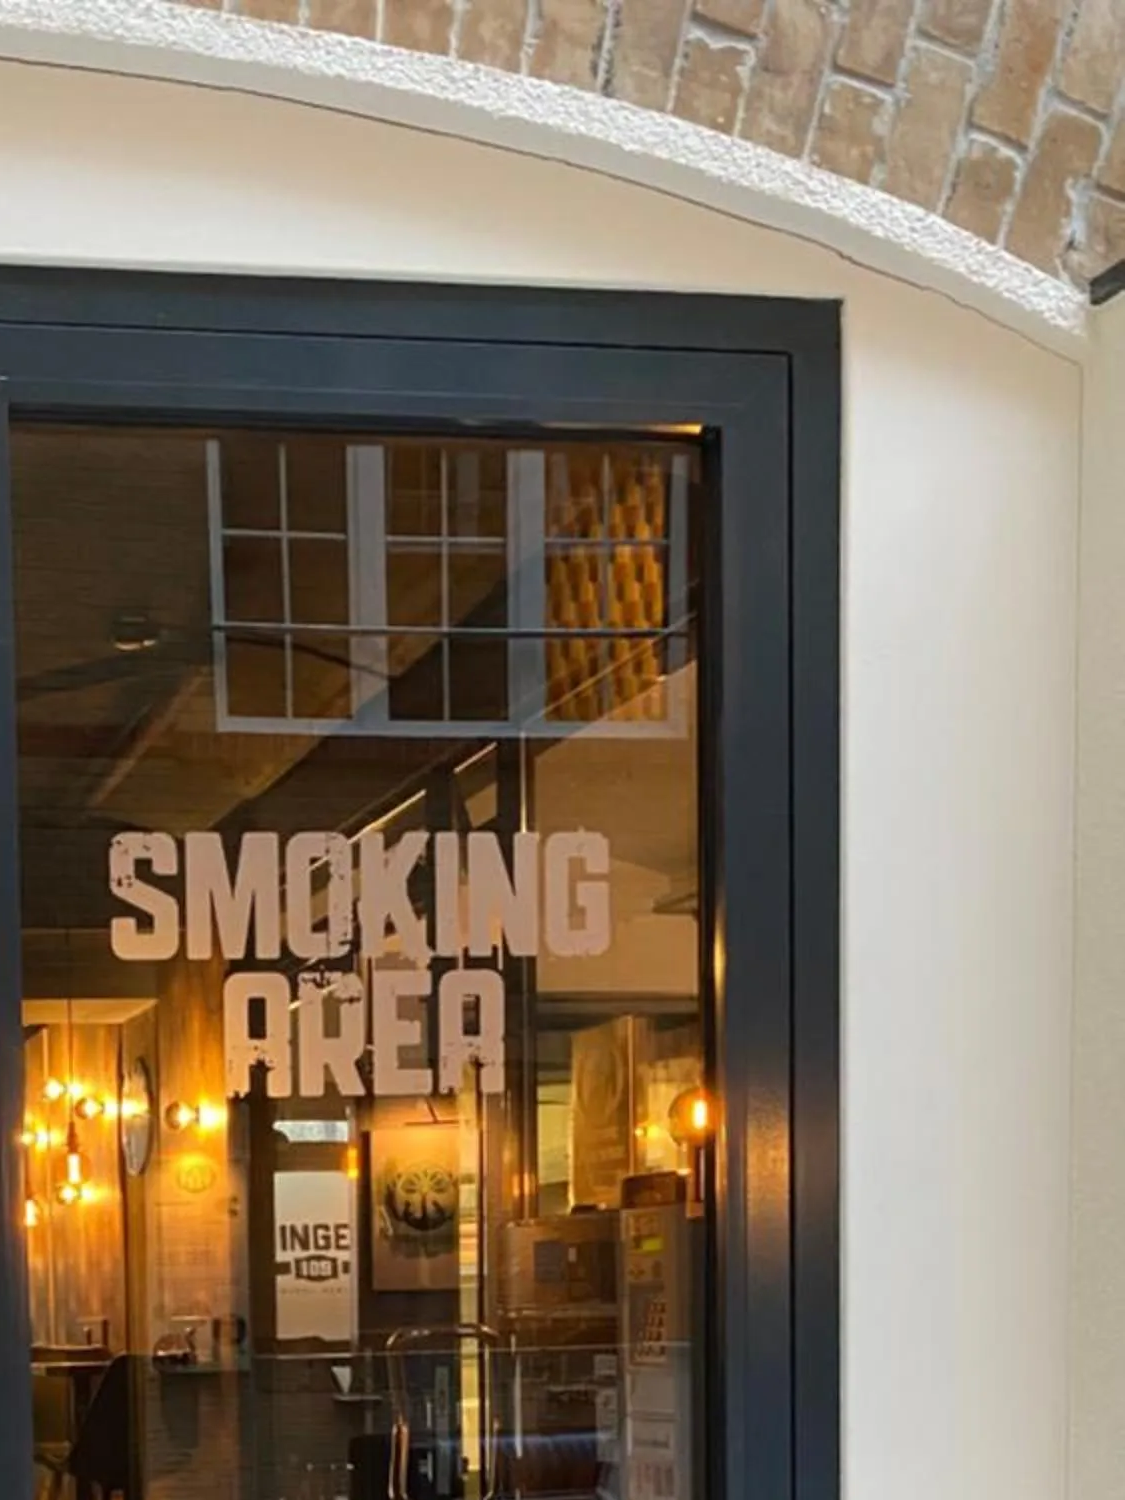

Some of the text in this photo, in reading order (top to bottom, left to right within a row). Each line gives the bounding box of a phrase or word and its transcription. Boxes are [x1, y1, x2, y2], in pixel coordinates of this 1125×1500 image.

[109, 829, 611, 962] SMOKING
[223, 968, 506, 1098] AREA
[279, 1223, 351, 1252] INGE
